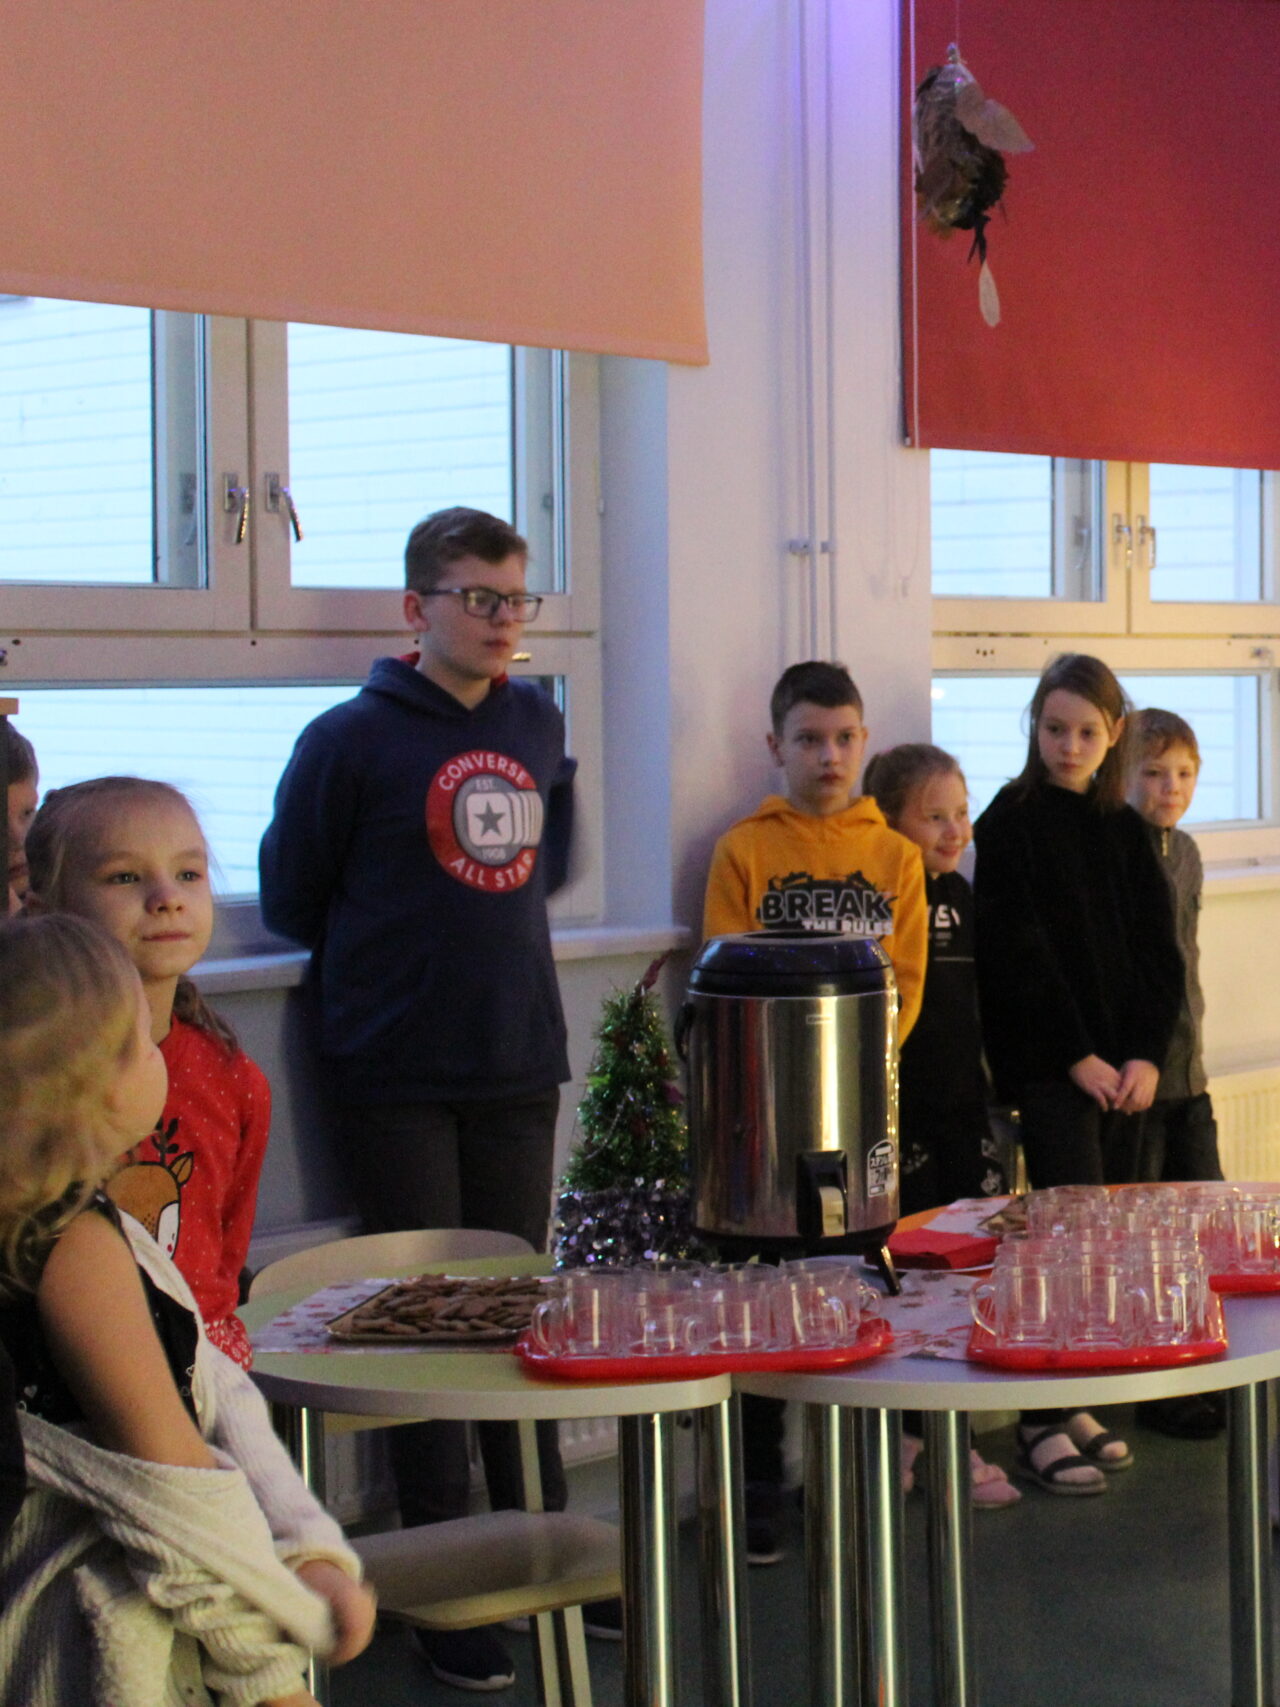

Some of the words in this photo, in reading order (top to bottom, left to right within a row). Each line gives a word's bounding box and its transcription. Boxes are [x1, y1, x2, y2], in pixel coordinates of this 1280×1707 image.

[438, 753, 528, 792] CONVERSE
[450, 857, 486, 886] ALL
[760, 889, 895, 924] BREAK
[801, 919, 838, 931] THE
[840, 920, 895, 936] RULES
